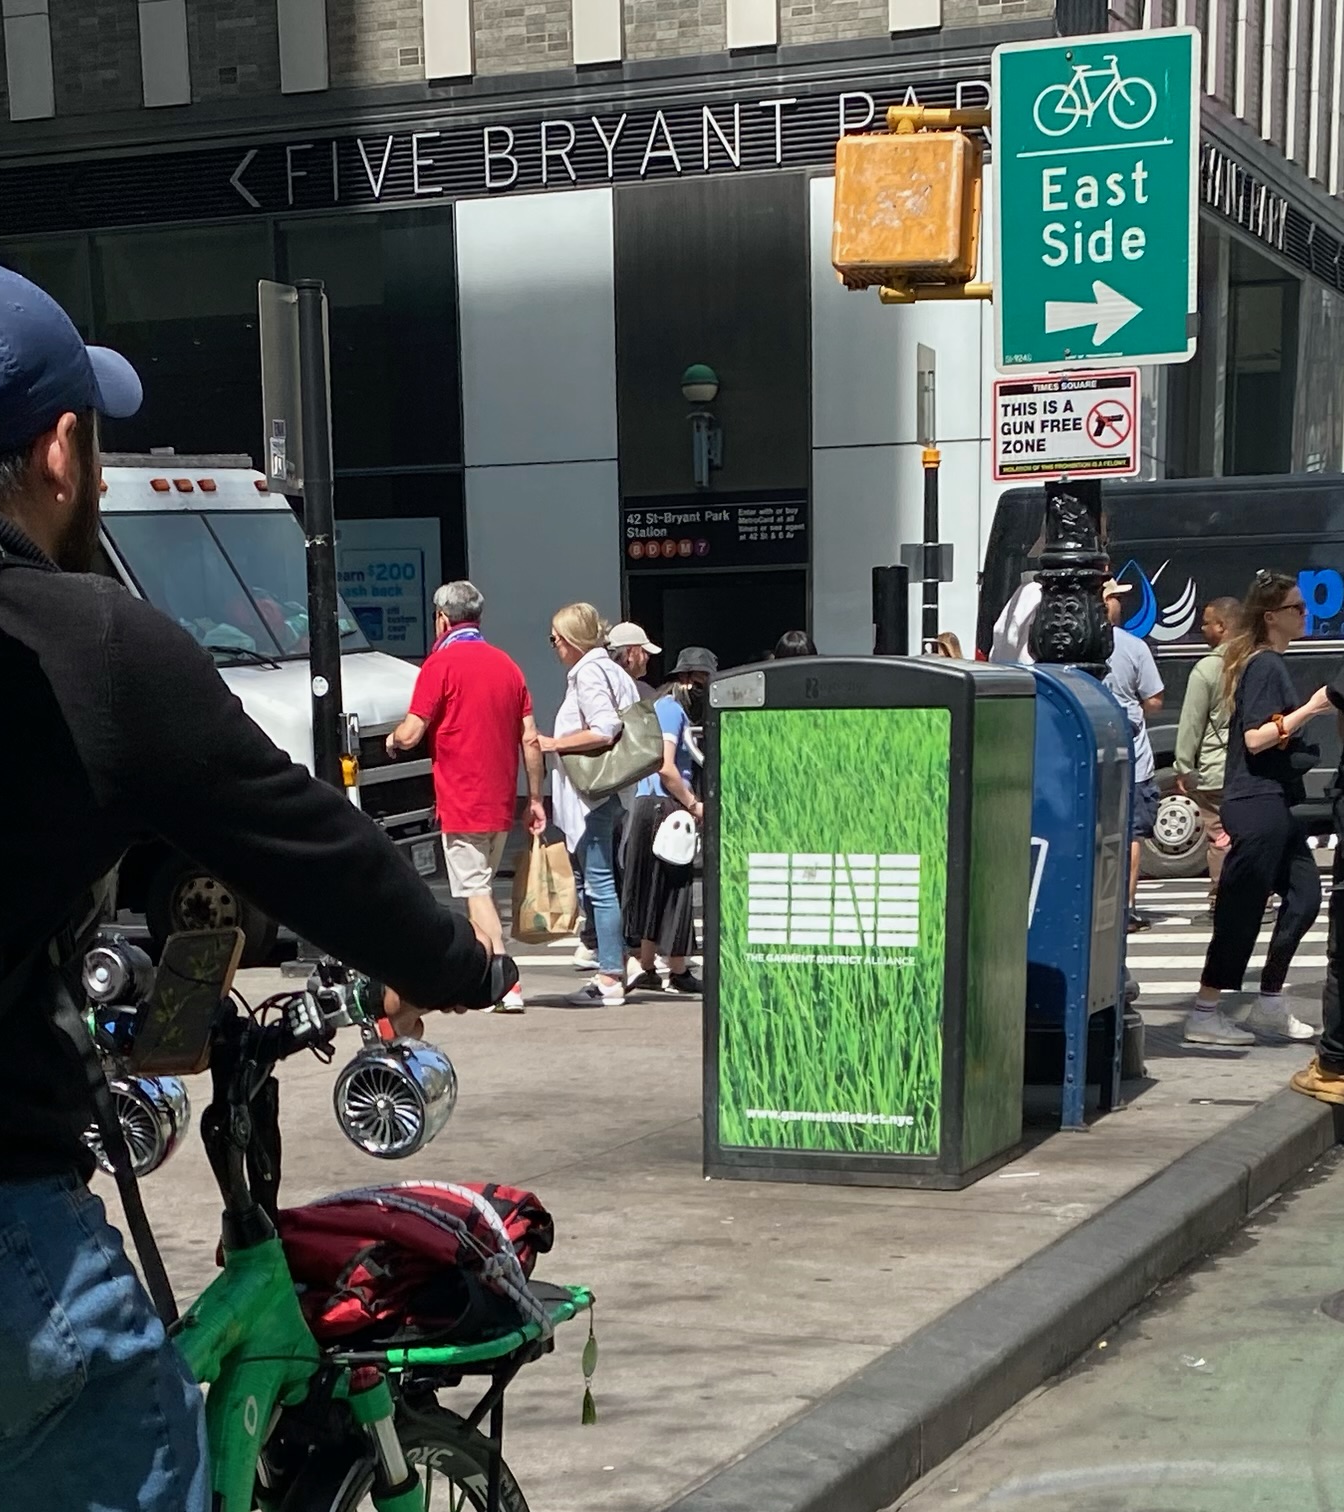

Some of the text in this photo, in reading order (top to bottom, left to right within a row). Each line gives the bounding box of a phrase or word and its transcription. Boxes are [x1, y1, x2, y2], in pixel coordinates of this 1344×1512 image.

[285, 130, 443, 206] FIVE
[483, 97, 798, 189] BRYANT
[1042, 159, 1149, 212] East
[1041, 217, 1147, 268] Side
[1032, 380, 1098, 393] TIMES SQUARE
[1001, 400, 1074, 417] THIS IS A
[1001, 418, 1083, 436] GUN FREE
[1002, 438, 1047, 454] ZONE
[626, 513, 642, 526] 42
[704, 509, 730, 522] Park
[626, 526, 668, 539] Station
[746, 952, 916, 968] THE GARMENT DISTRICT ALLIANCE
[746, 1108, 914, 1128] www.garmentdistrict.nyc
